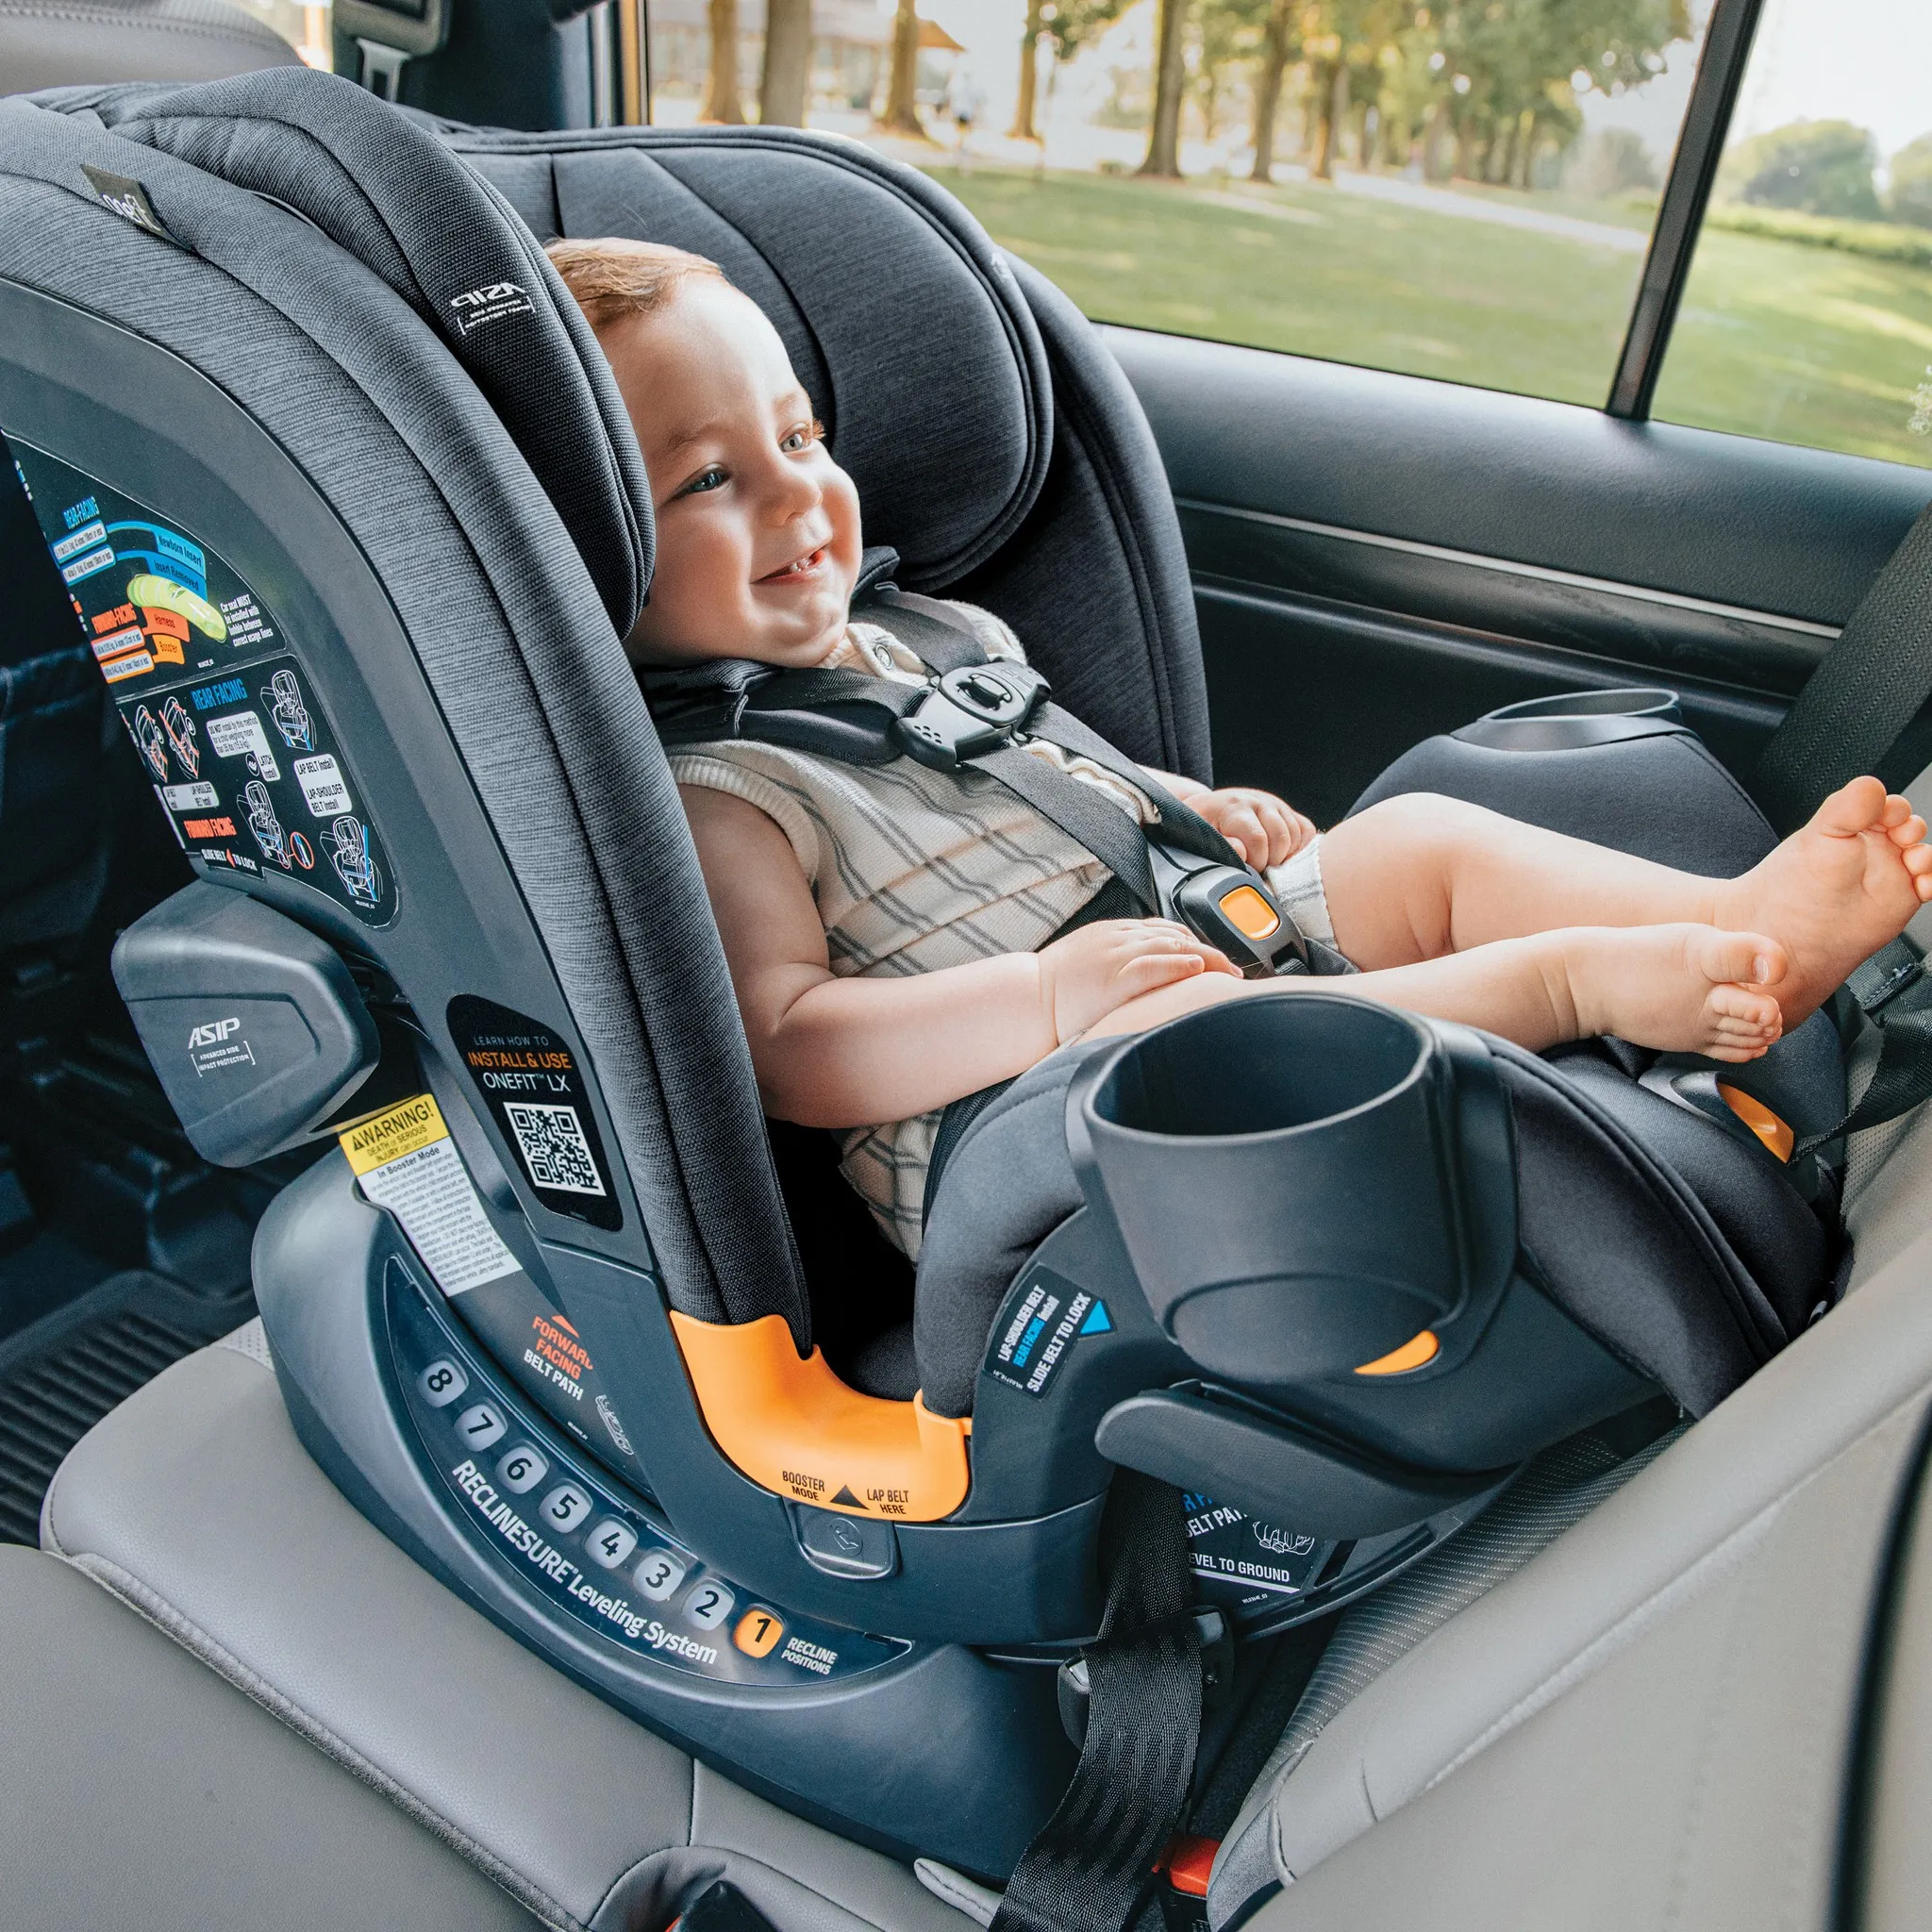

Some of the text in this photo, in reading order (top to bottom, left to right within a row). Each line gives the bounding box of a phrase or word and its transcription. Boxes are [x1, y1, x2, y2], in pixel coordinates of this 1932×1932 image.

[158, 534, 202, 567] Newborn Insert
[154, 559, 199, 591] Insert Removed
[154, 614, 176, 629] Harness
[158, 641, 178, 654] Booster
[192, 678, 248, 710] REAR FACING
[258, 754, 274, 766] LATCH
[296, 757, 335, 775] LAP BELT Install
[306, 783, 344, 800] LAP-SHOULDER
[311, 799, 341, 813] BELT Install
[241, 857, 258, 871] LOCK
[189, 1017, 241, 1049] ASIP
[475, 1036, 549, 1046] LEARN HOW TO
[217, 1054, 249, 1067] PROTECTION
[468, 1051, 572, 1069] INSTALL & USE
[547, 1075, 571, 1092] LX
[359, 1101, 434, 1147] WARNING!
[366, 1141, 390, 1157] DEATH
[397, 1124, 427, 1143] SERIOUS
[375, 1147, 399, 1162] INJURY
[377, 1147, 441, 1178] In Booster Mode
[998, 1284, 1046, 1362] LAP-SHOULDER BELT
[1026, 1291, 1091, 1392] SLIDE BELT TO LOCK
[535, 1338, 582, 1380] FACING
[524, 1348, 584, 1401] BELT PATH
[782, 1471, 825, 1492] BOOSTER
[791, 1486, 820, 1501] MODE
[427, 1368, 773, 1643] 8 7 6 5 4 3 2 1
[867, 1489, 908, 1503] LAP BELT
[880, 1505, 907, 1515] HERE
[1189, 1552, 1290, 1583] EVEL TO GROUND
[567, 1574, 647, 1639] Leveling
[643, 1622, 718, 1666] System
[781, 1648, 834, 1675] POSITIONS
[787, 1637, 839, 1666] RECLINE
